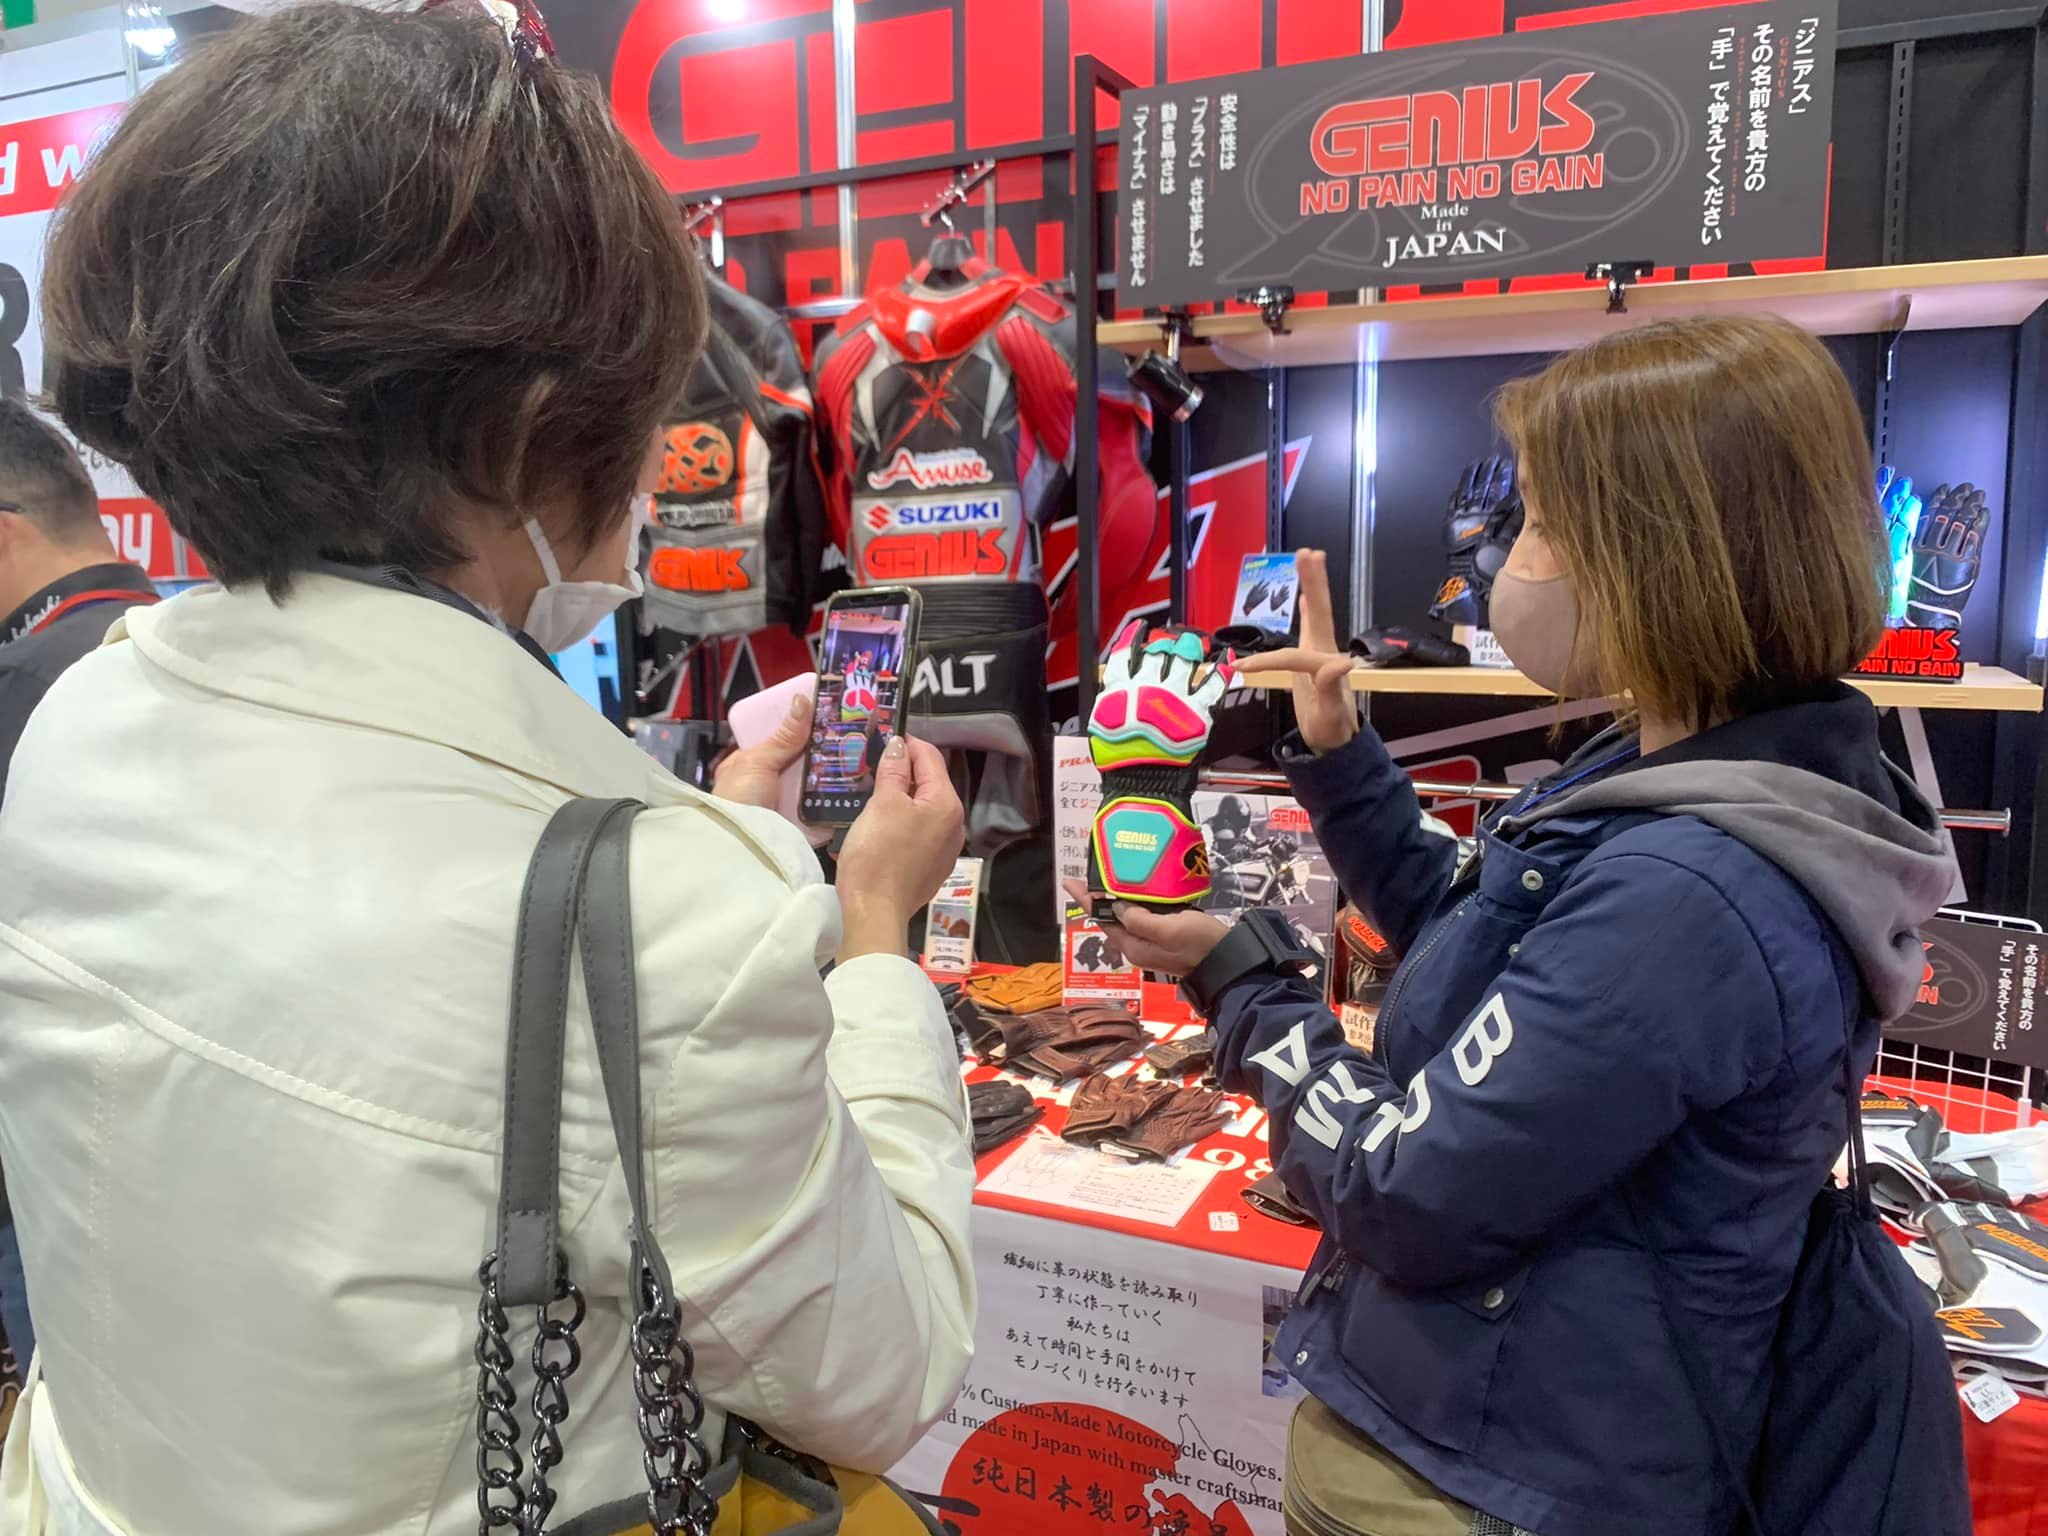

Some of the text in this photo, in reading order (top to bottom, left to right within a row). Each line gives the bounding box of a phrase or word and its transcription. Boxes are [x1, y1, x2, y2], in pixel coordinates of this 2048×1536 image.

[1789, 17, 1819, 114] 「ジニアス」
[1220, 93, 1239, 170] 安全性は
[1310, 72, 1596, 177] GENIUS
[1701, 27, 1735, 245] 「手」で覚えてください
[1744, 23, 1774, 192] その名前を貴方の
[1300, 152, 1604, 216] NO PAIN NO GAIN
[1420, 203, 1469, 220] Made
[1382, 228, 1507, 268] JAPAN
[1436, 218, 1453, 232] in
[899, 503, 999, 525] SUZUKI
[864, 528, 1007, 579] GENIUS
[1892, 660, 1915, 674] NO
[1921, 662, 1960, 677] GAIN
[1038, 1284, 1162, 1327] 丁寧に作っていく
[1066, 1316, 1130, 1344] 私たちは
[1006, 1327, 1197, 1387] あえて時間と手間をかけて
[1013, 1355, 1188, 1409] モノづくりを行ないます
[962, 1418, 1006, 1437] made
[1012, 1424, 1028, 1442] in
[1032, 1431, 1082, 1457] Japan
[1087, 1447, 1124, 1471] with
[1130, 1460, 1191, 1487] master
[981, 1388, 1100, 1433] Custom-Made
[1106, 1420, 1207, 1462] Motorcycle
[1213, 1448, 1283, 1483] Gloves.
